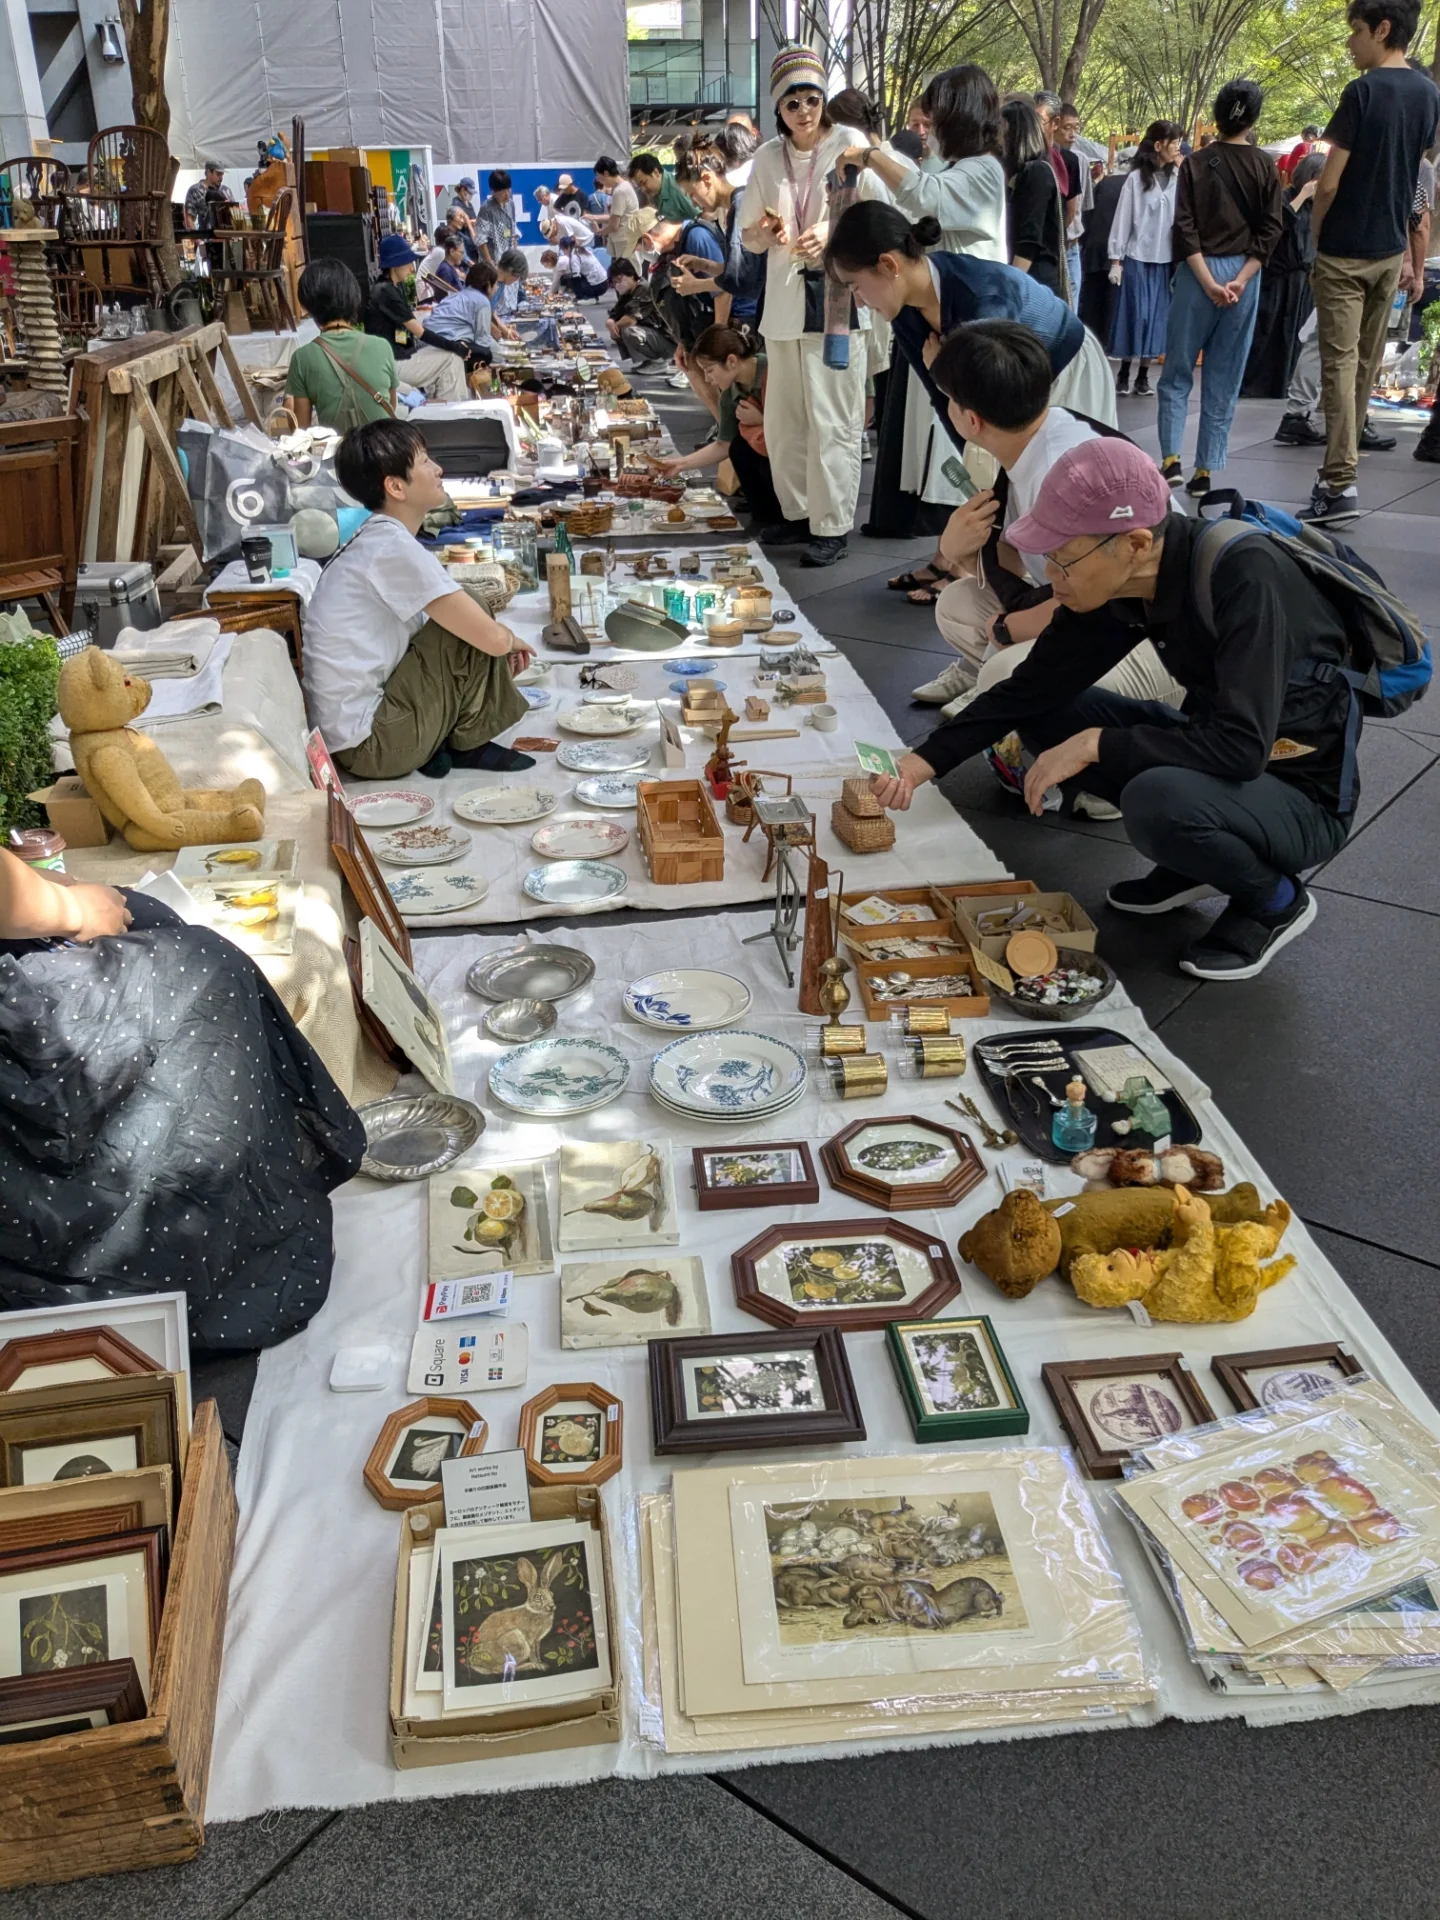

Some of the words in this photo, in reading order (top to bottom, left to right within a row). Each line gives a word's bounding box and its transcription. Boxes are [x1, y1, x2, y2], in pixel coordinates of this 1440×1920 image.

[396, 175, 408, 192] A
[439, 1285, 450, 1306] PayPay
[429, 1338, 446, 1372] Square
[460, 1368, 469, 1385] VISA
